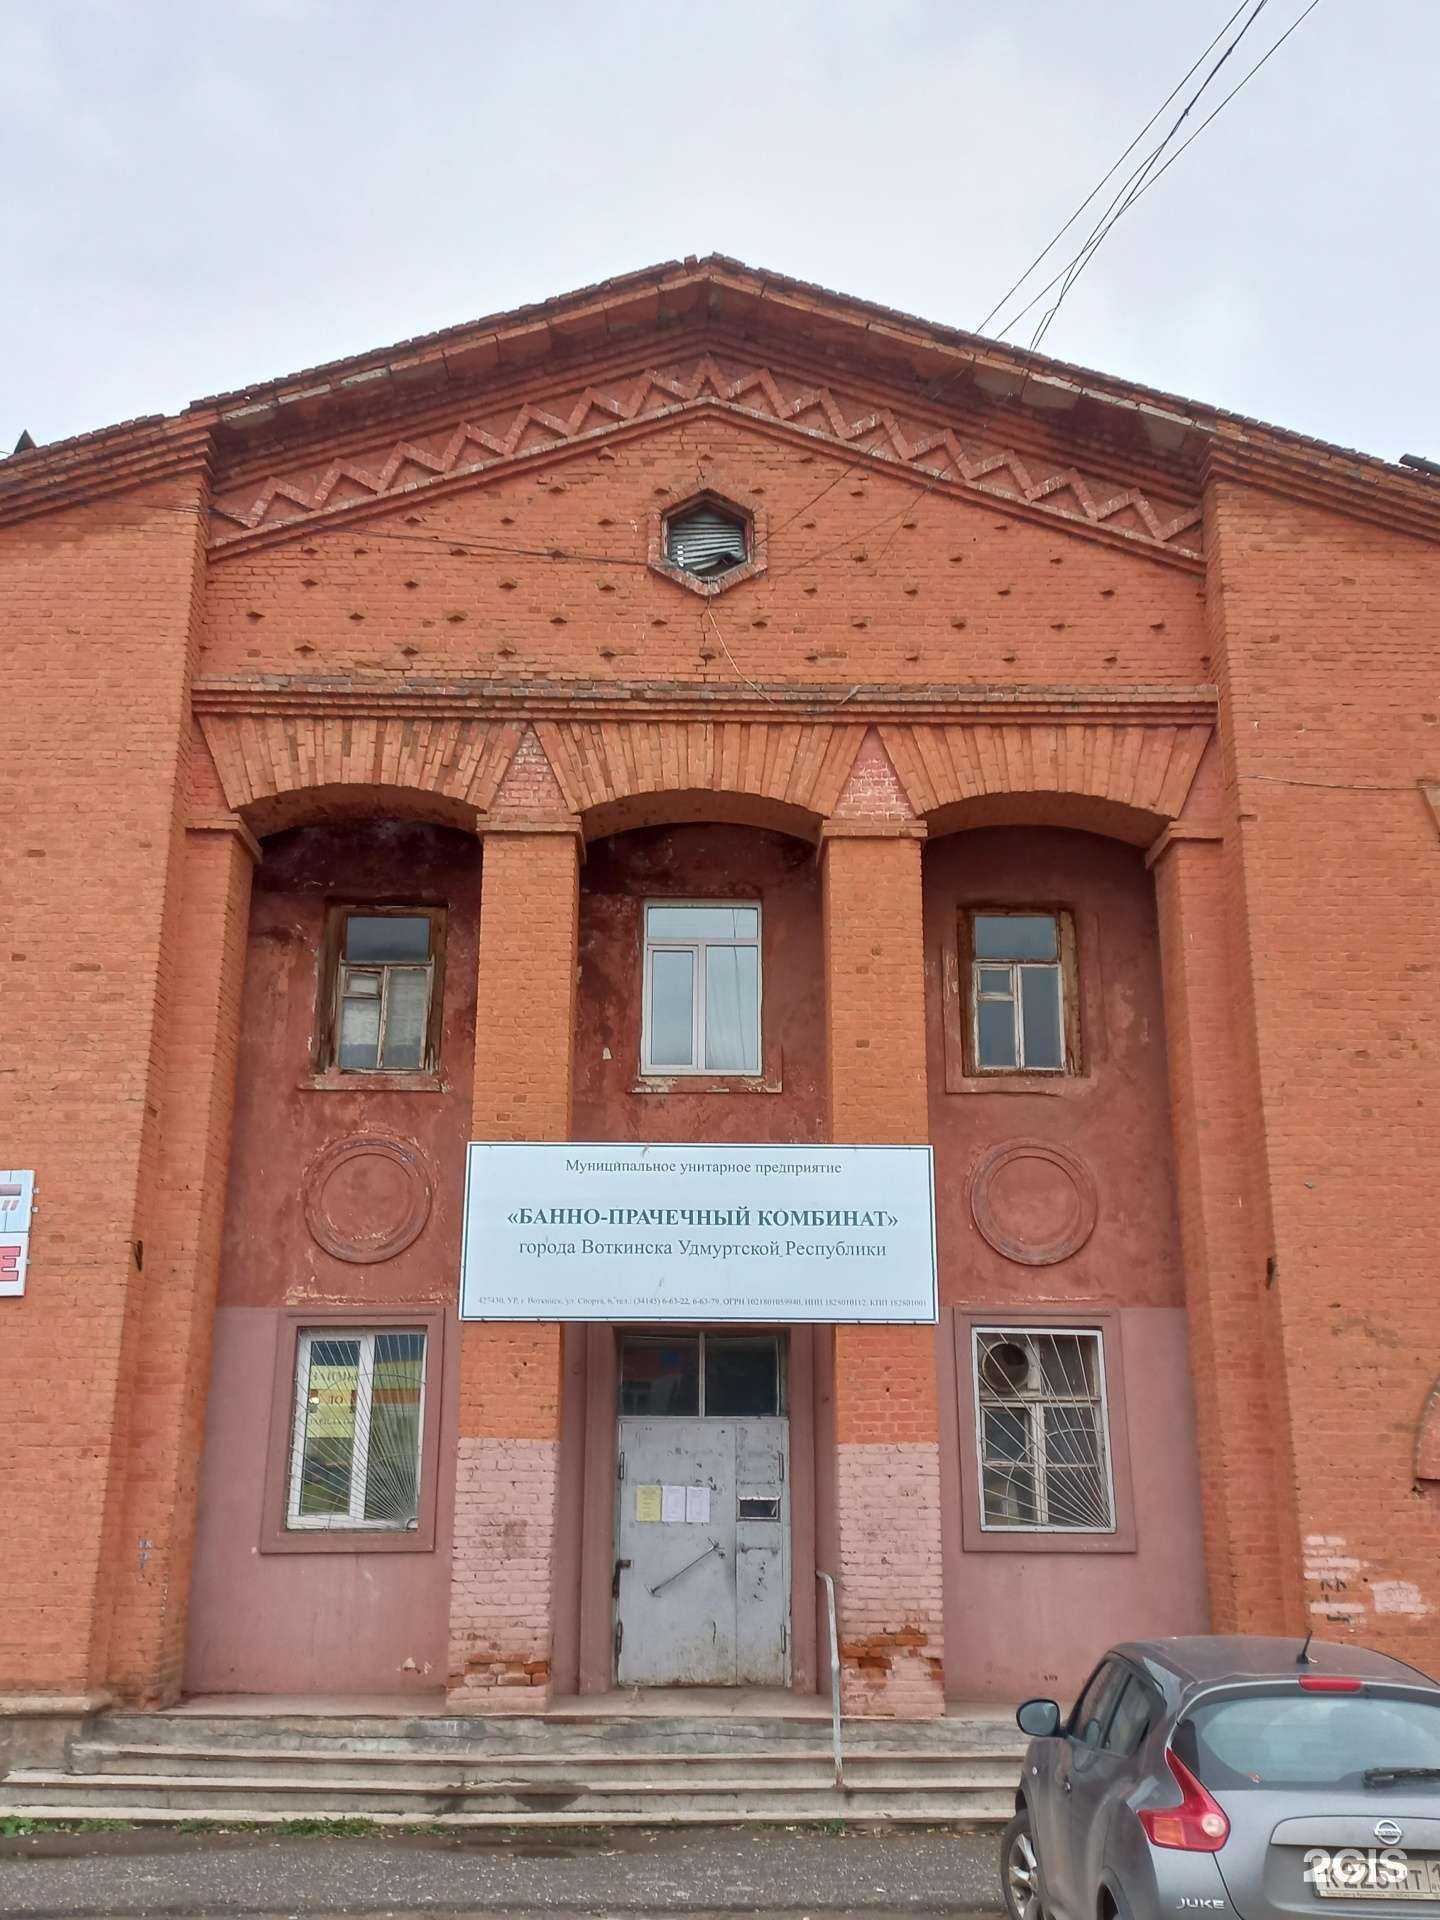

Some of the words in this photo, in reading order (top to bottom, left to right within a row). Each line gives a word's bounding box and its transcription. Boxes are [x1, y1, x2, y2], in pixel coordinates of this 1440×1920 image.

[565, 1159, 676, 1174] Муниципальное
[680, 1161, 752, 1175] унитарное
[755, 1163, 842, 1176] предприятие
[507, 1206, 751, 1227] «БАННО-ПРАЧЕЧНЫЙ
[757, 1209, 899, 1227] КОМБИНАТ»
[519, 1241, 576, 1257] города
[582, 1239, 673, 1255] Воткинска
[678, 1240, 780, 1259] Удмуртской
[785, 1241, 887, 1259] Республики
[1176, 1899, 1225, 1909] JUKE
